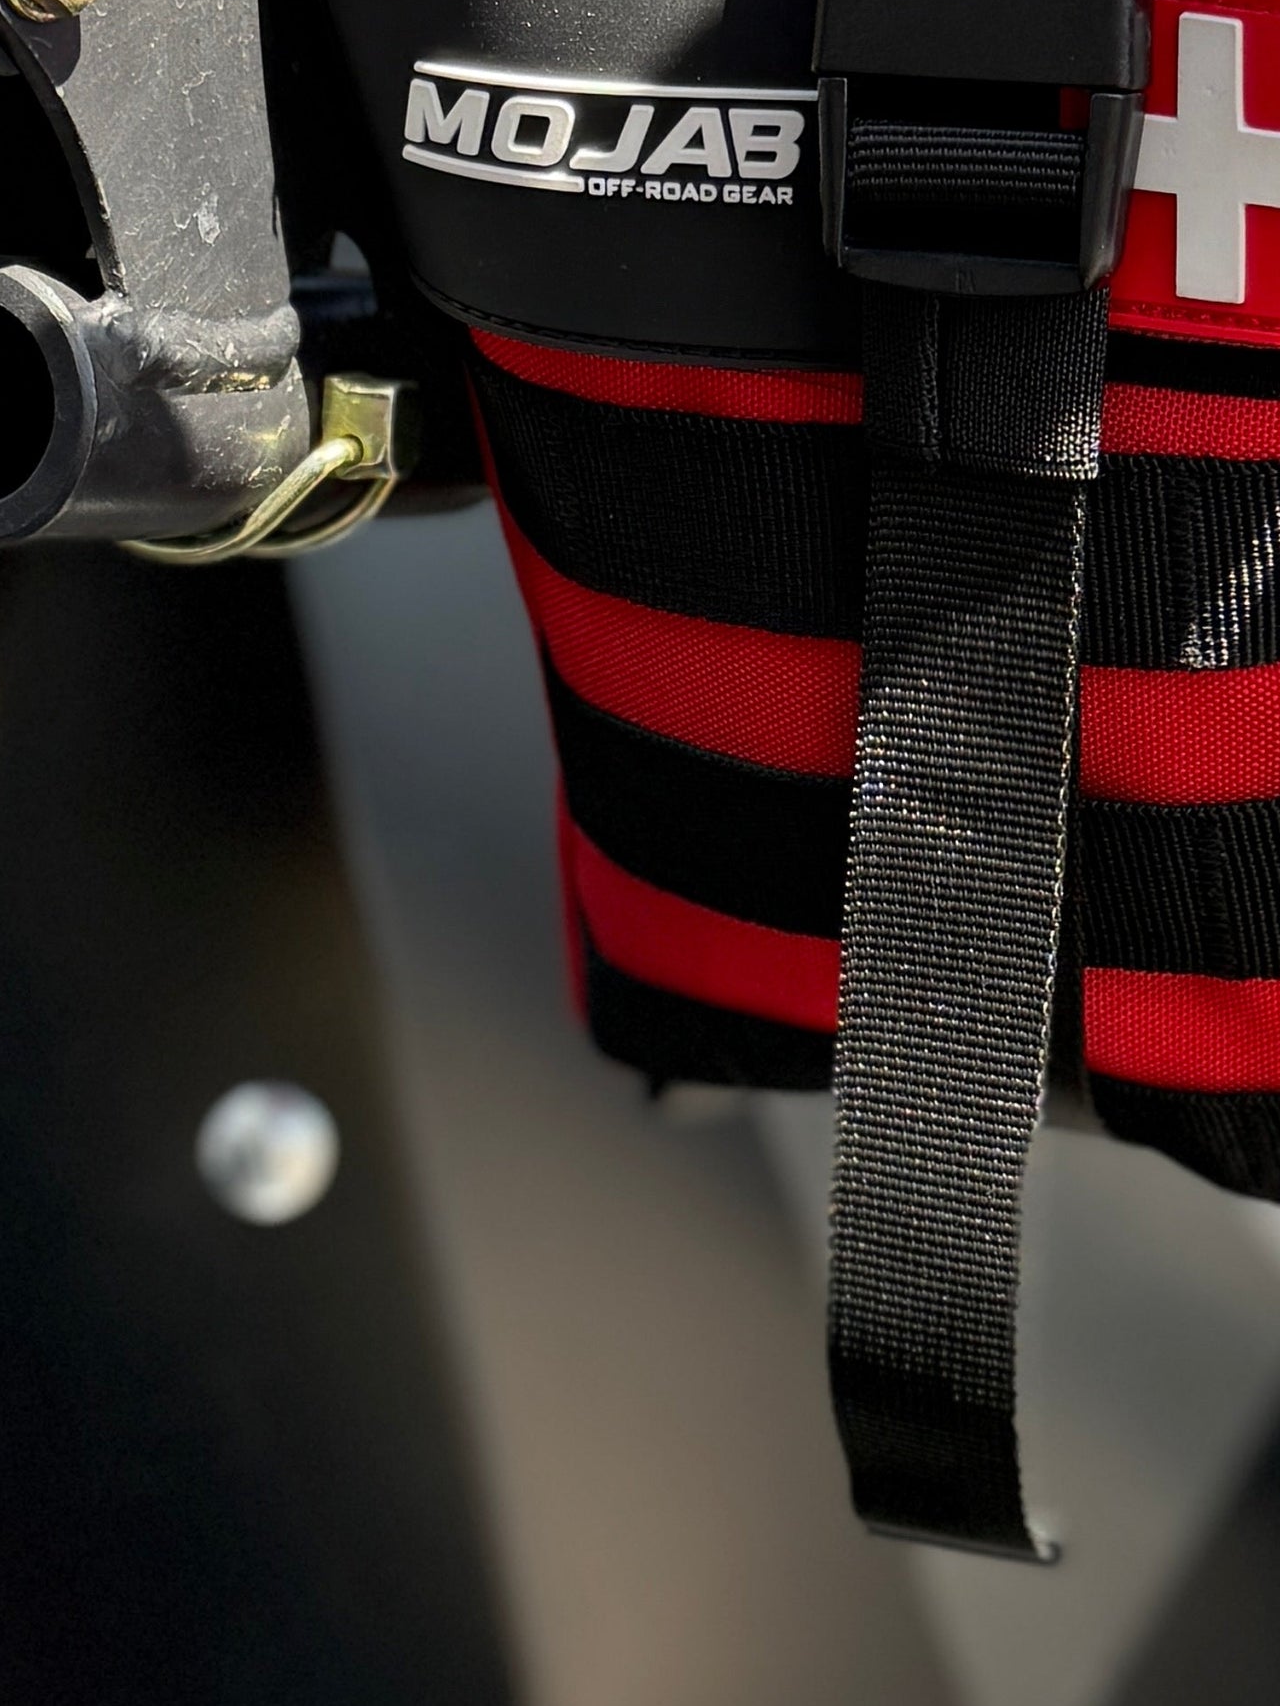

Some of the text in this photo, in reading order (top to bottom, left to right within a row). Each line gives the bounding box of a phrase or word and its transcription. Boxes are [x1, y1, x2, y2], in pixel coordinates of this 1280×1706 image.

[404, 78, 805, 180] MOJAB
[588, 177, 793, 205] OFF-ROAD GEAR
